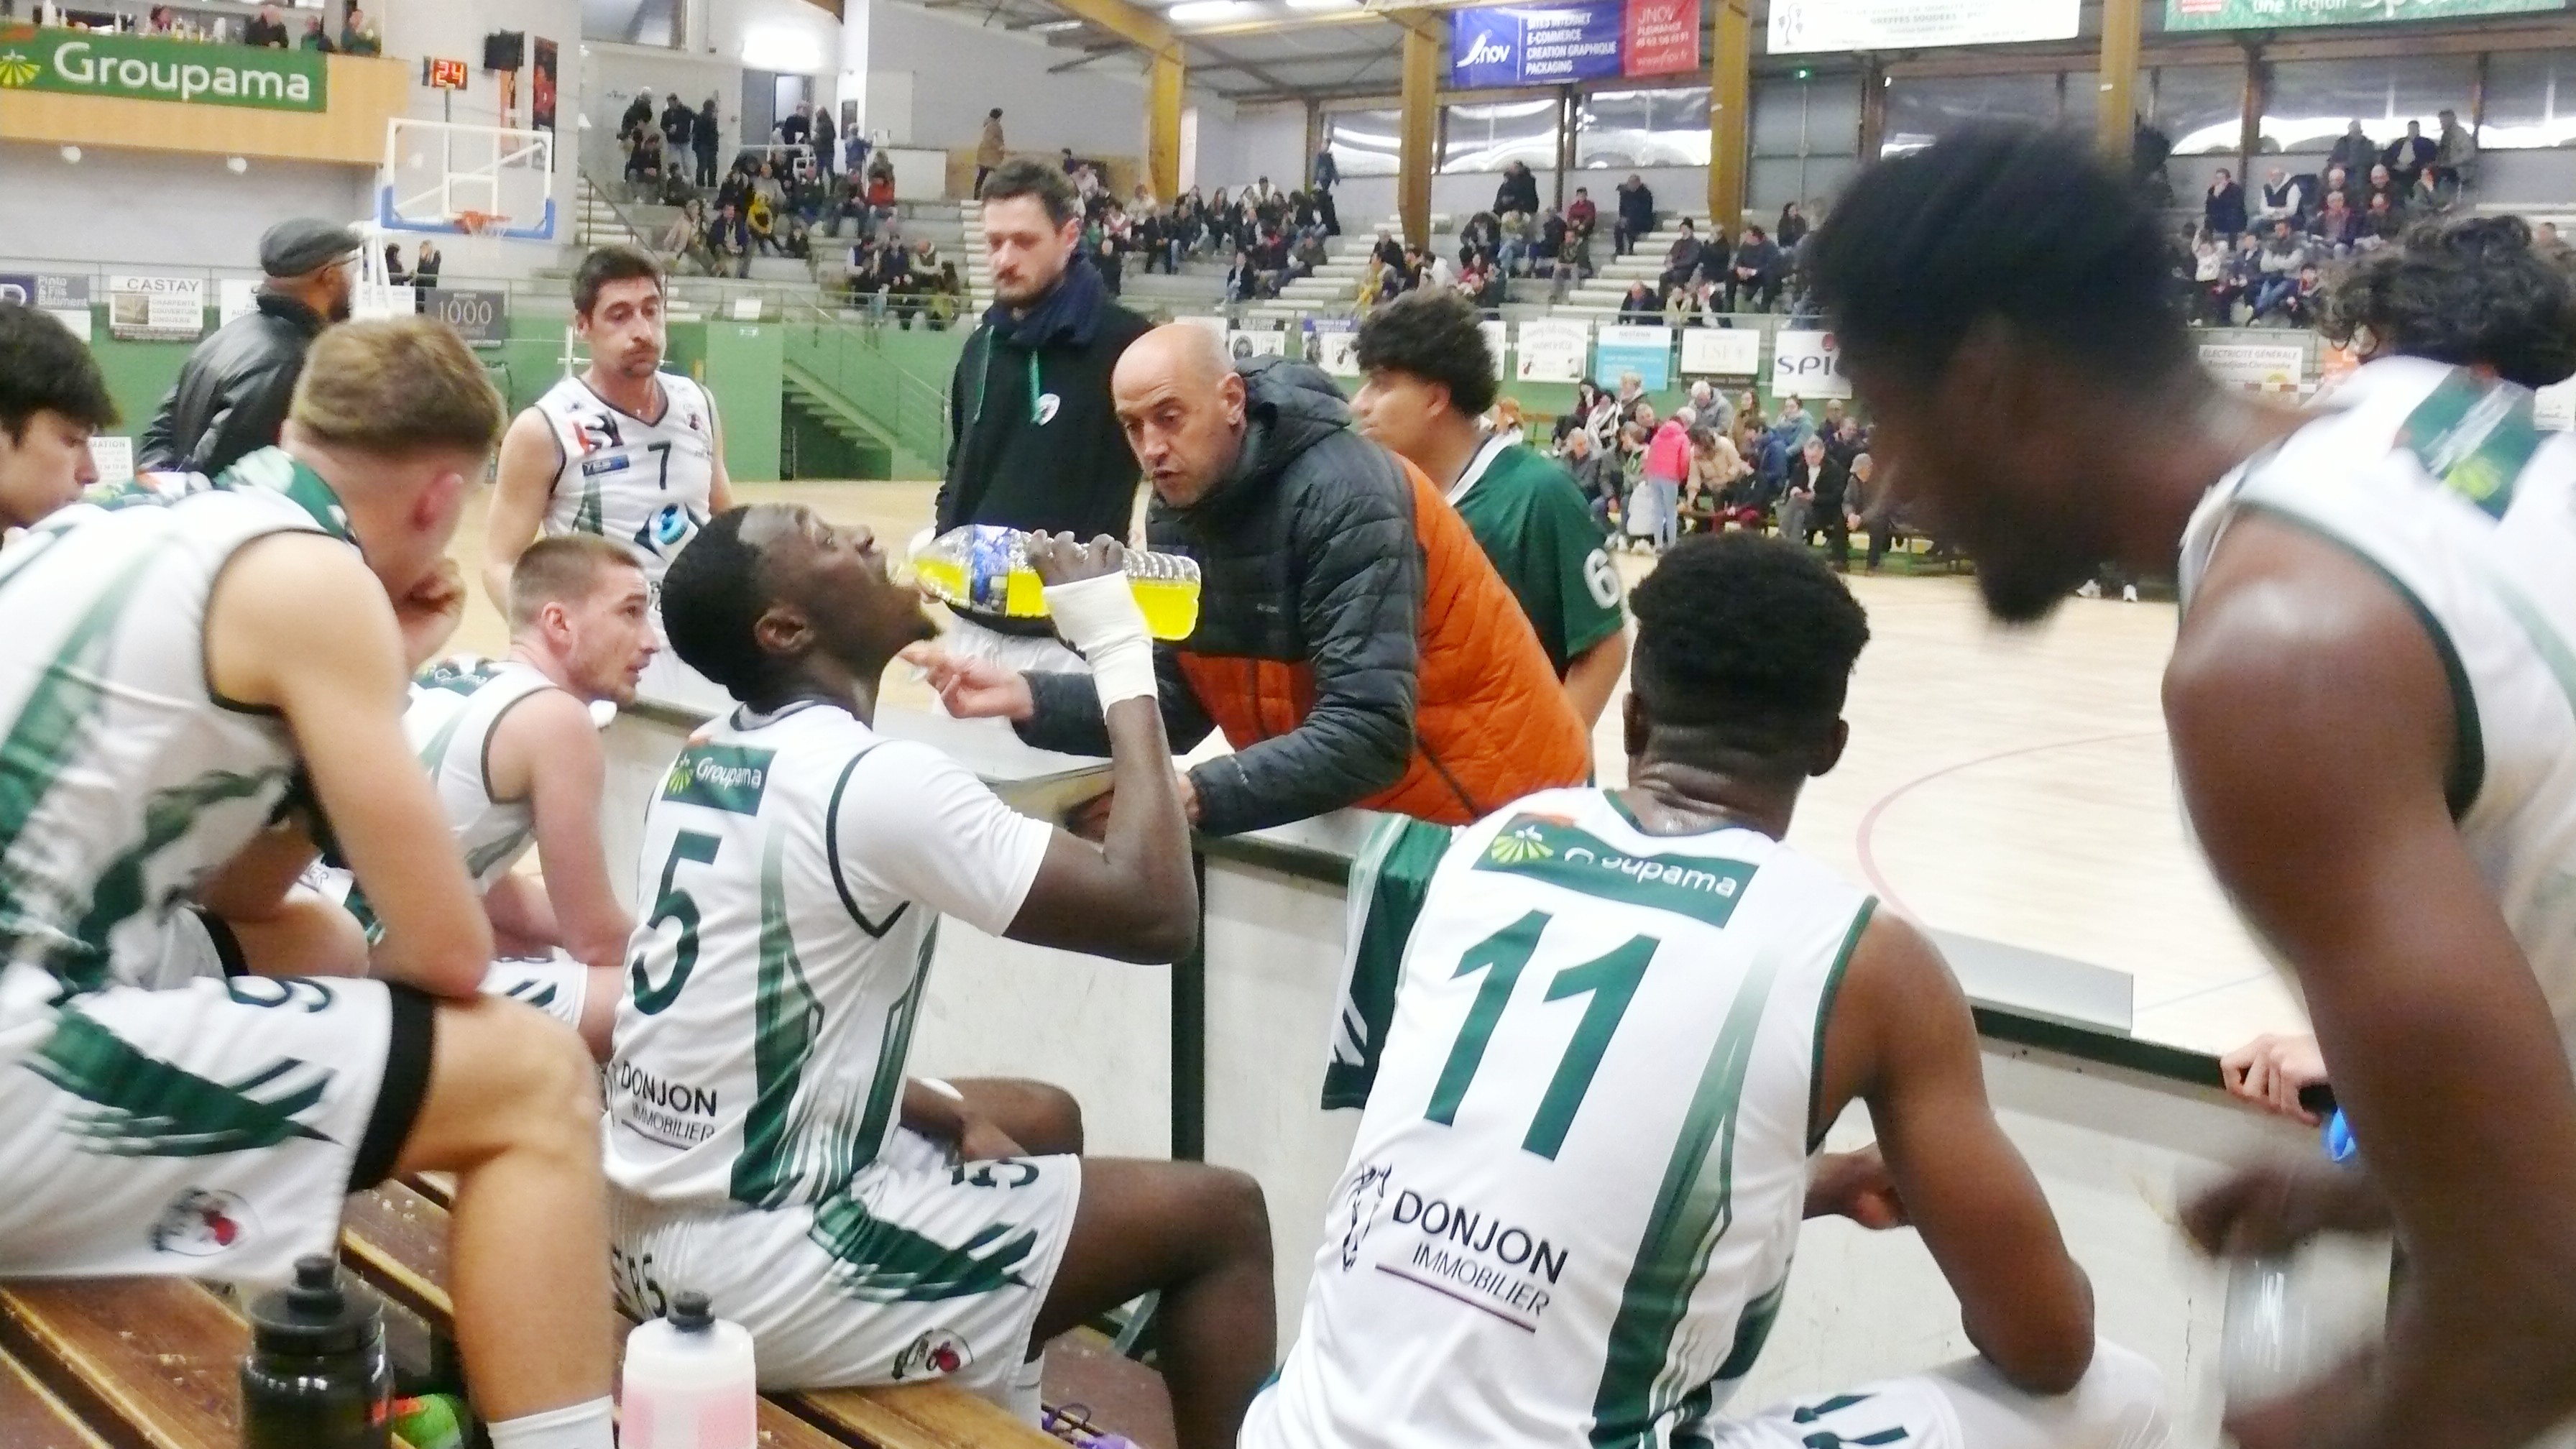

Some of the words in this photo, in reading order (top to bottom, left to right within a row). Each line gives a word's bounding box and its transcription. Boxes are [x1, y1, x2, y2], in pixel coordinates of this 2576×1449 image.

[1526, 29, 1582, 45] E-COMMERCE
[1526, 45, 1567, 60] CREATION
[1567, 41, 1616, 58] GRAPHIQUE
[53, 41, 310, 102] Groupama
[436, 61, 464, 86] 24
[1525, 60, 1573, 75] PACKAGING
[127, 278, 200, 293] CASTAY
[438, 300, 492, 324] 1000
[1777, 356, 1834, 376] SPI
[648, 441, 671, 489] 7
[1583, 548, 1621, 610] 6
[696, 757, 762, 791] Groupama
[631, 827, 722, 1016] 5
[1423, 908, 1661, 1162] 11
[621, 1060, 717, 1117] DONJON
[632, 1100, 714, 1142] IMMOBILIER
[1393, 1189, 1569, 1284] DONJON
[1412, 1242, 1550, 1316] IMMOBILIER
